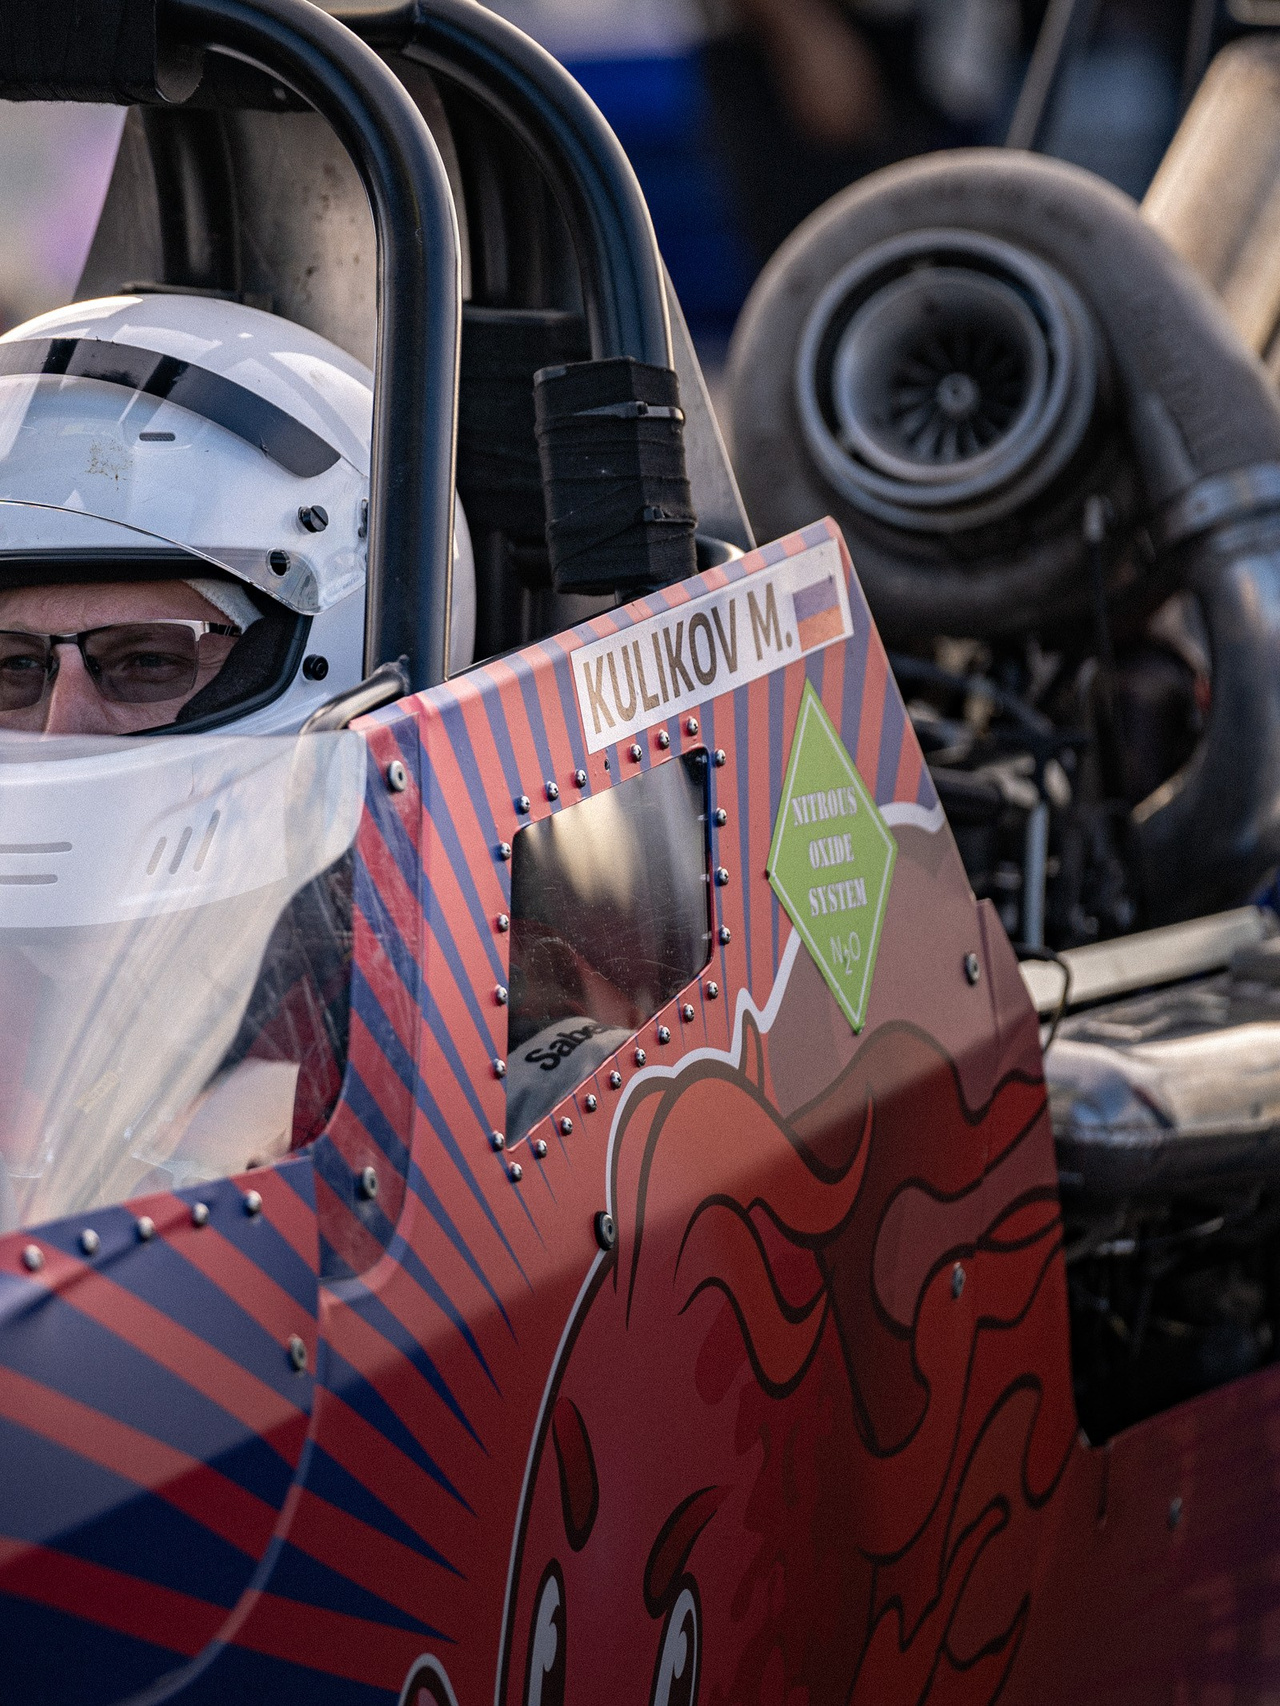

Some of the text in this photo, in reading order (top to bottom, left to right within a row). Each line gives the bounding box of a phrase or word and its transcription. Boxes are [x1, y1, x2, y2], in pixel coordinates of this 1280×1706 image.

[583, 582, 793, 735] KULIKOV M.
[791, 786, 858, 828] NITROUS
[808, 833, 855, 870] OXIDE
[808, 877, 868, 917] SYSTEM
